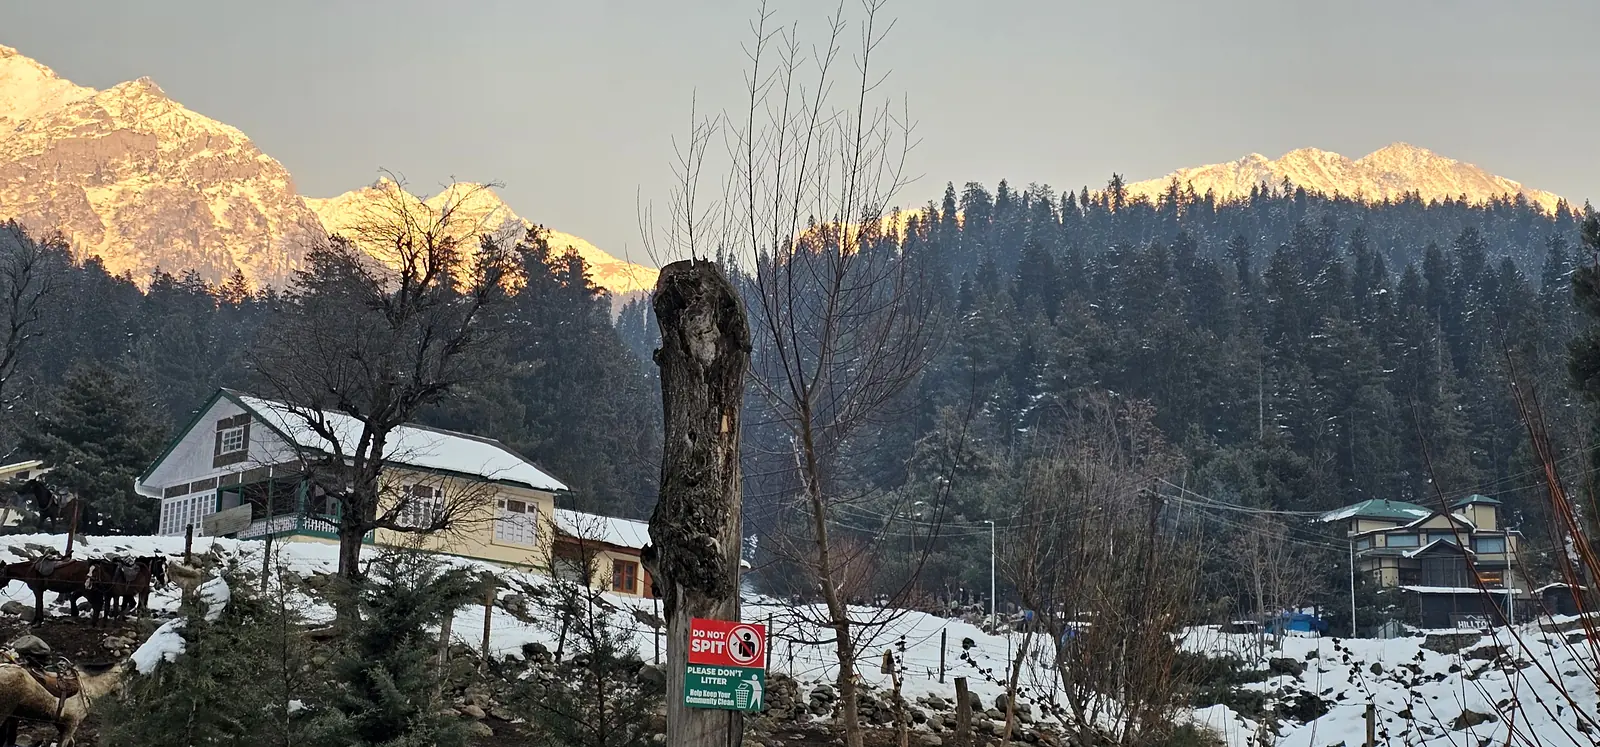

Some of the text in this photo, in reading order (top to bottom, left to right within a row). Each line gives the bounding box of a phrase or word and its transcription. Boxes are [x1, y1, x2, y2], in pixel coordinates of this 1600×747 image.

[707, 631, 725, 639] NOT
[692, 639, 725, 654] SPIT
[701, 677, 727, 685] LITTER
[686, 696, 734, 706] Community Clean
